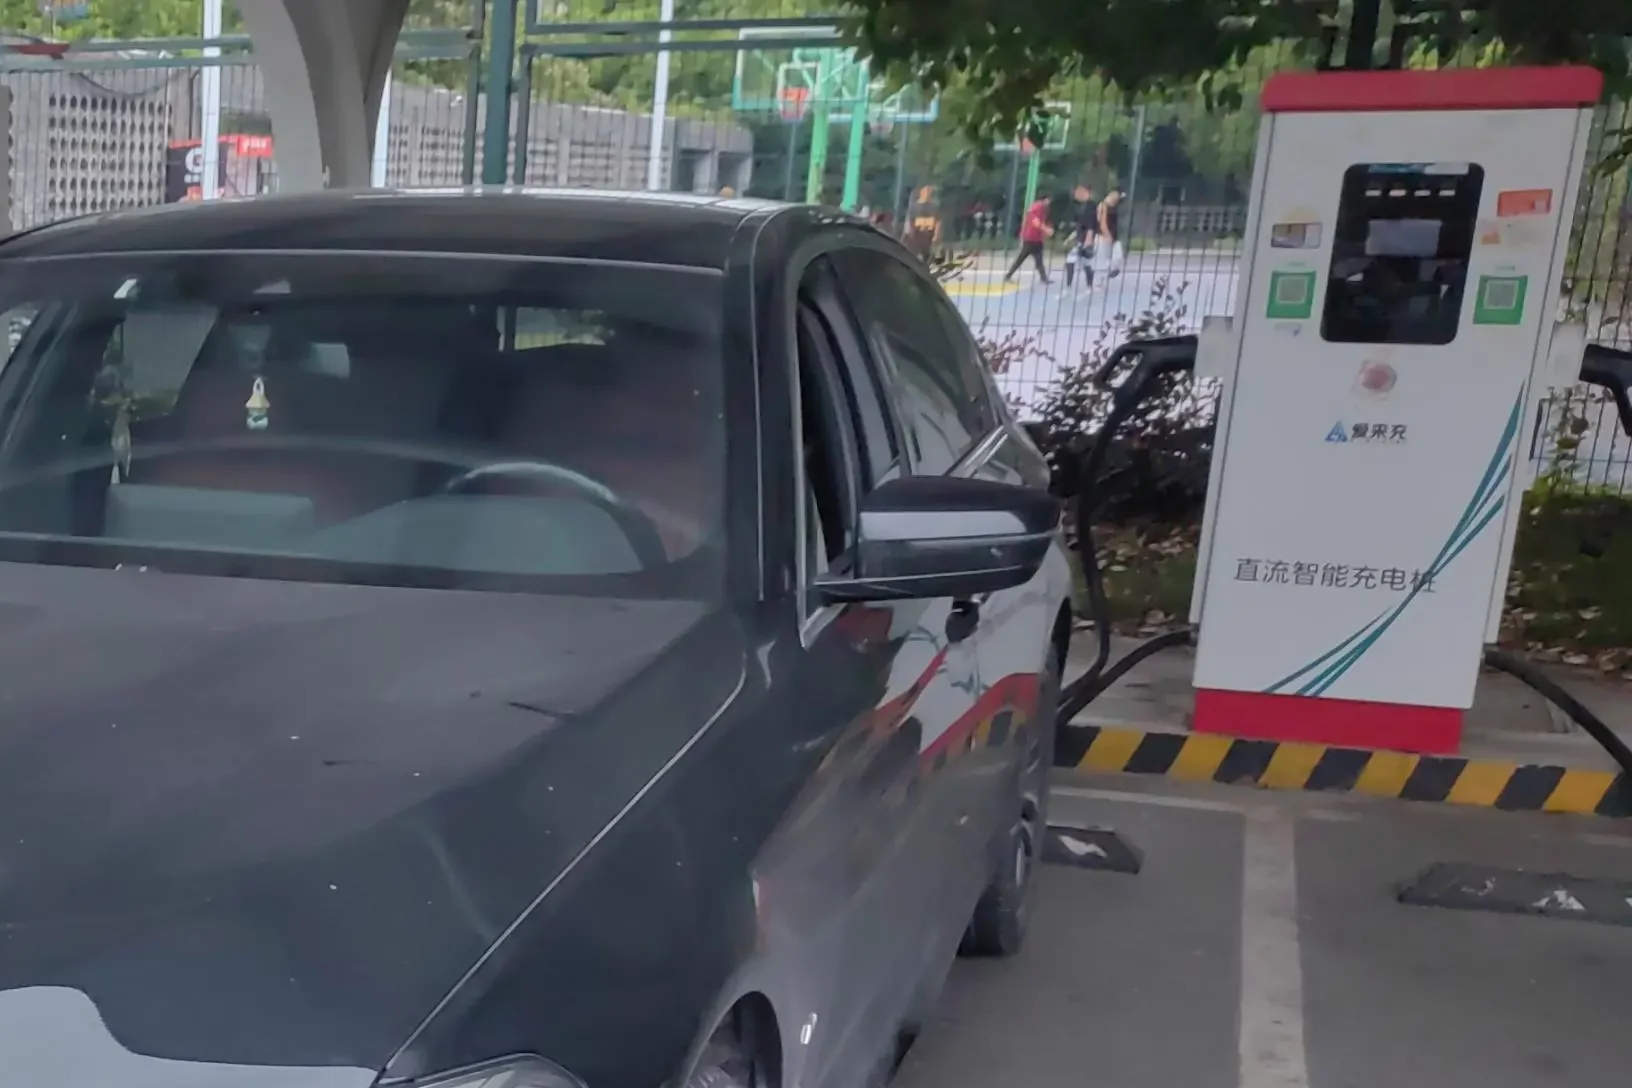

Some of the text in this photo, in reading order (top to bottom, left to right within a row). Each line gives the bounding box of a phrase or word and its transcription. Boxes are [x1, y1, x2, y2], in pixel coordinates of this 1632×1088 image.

[1233, 557, 1437, 593] 直流智能充电桩
